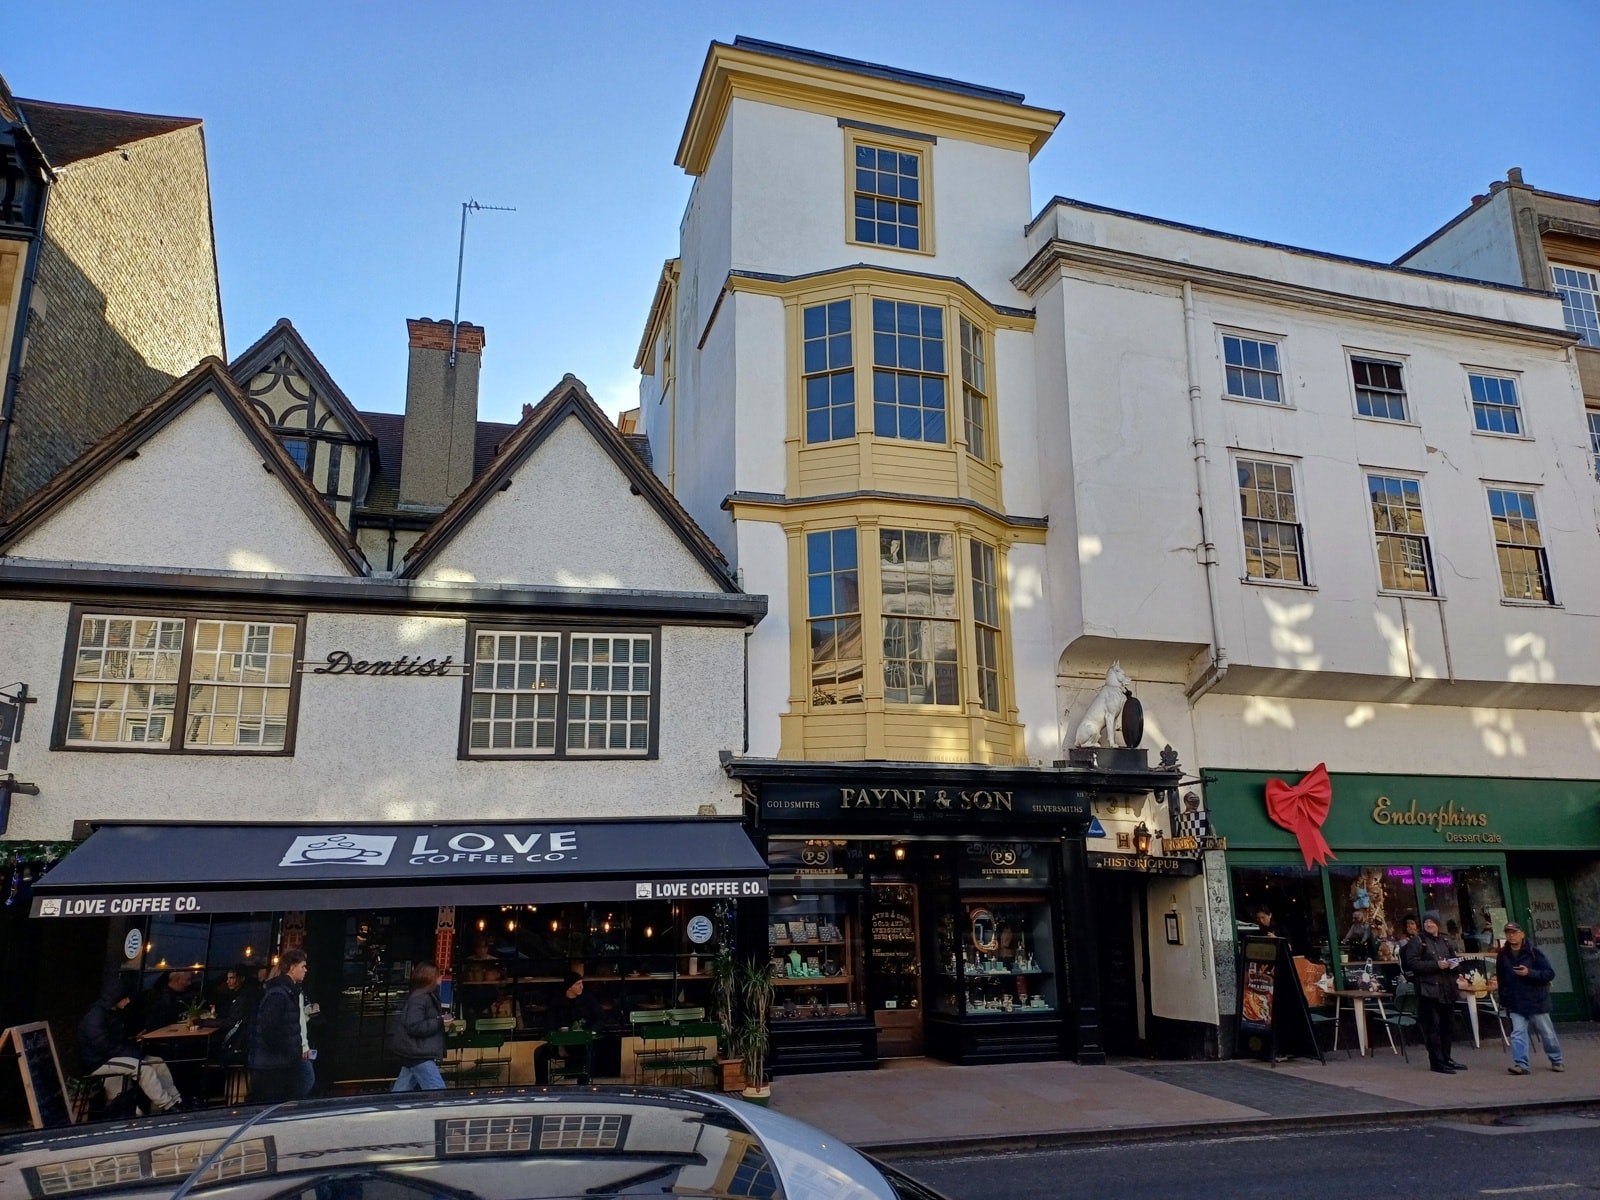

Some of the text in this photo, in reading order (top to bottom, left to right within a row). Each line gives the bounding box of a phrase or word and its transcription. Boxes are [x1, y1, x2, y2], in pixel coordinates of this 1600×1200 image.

[314, 651, 452, 676] Dentist
[766, 800, 820, 809] GOLDSMITHS
[840, 788, 1014, 811] PAYNE & SON
[1032, 804, 1083, 813] SILVERSMITHS
[1373, 796, 1487, 832] Endorphins
[412, 831, 577, 854] LOVE
[1446, 832, 1502, 843] Dessert Cafe
[409, 854, 514, 865] COFFEE
[1103, 857, 1179, 869] HISTORIC PUB
[656, 881, 764, 896] LOVE COFFEE CO.
[65, 897, 201, 914] LOVE COFFEE CO.
[1531, 902, 1556, 913] MORE
